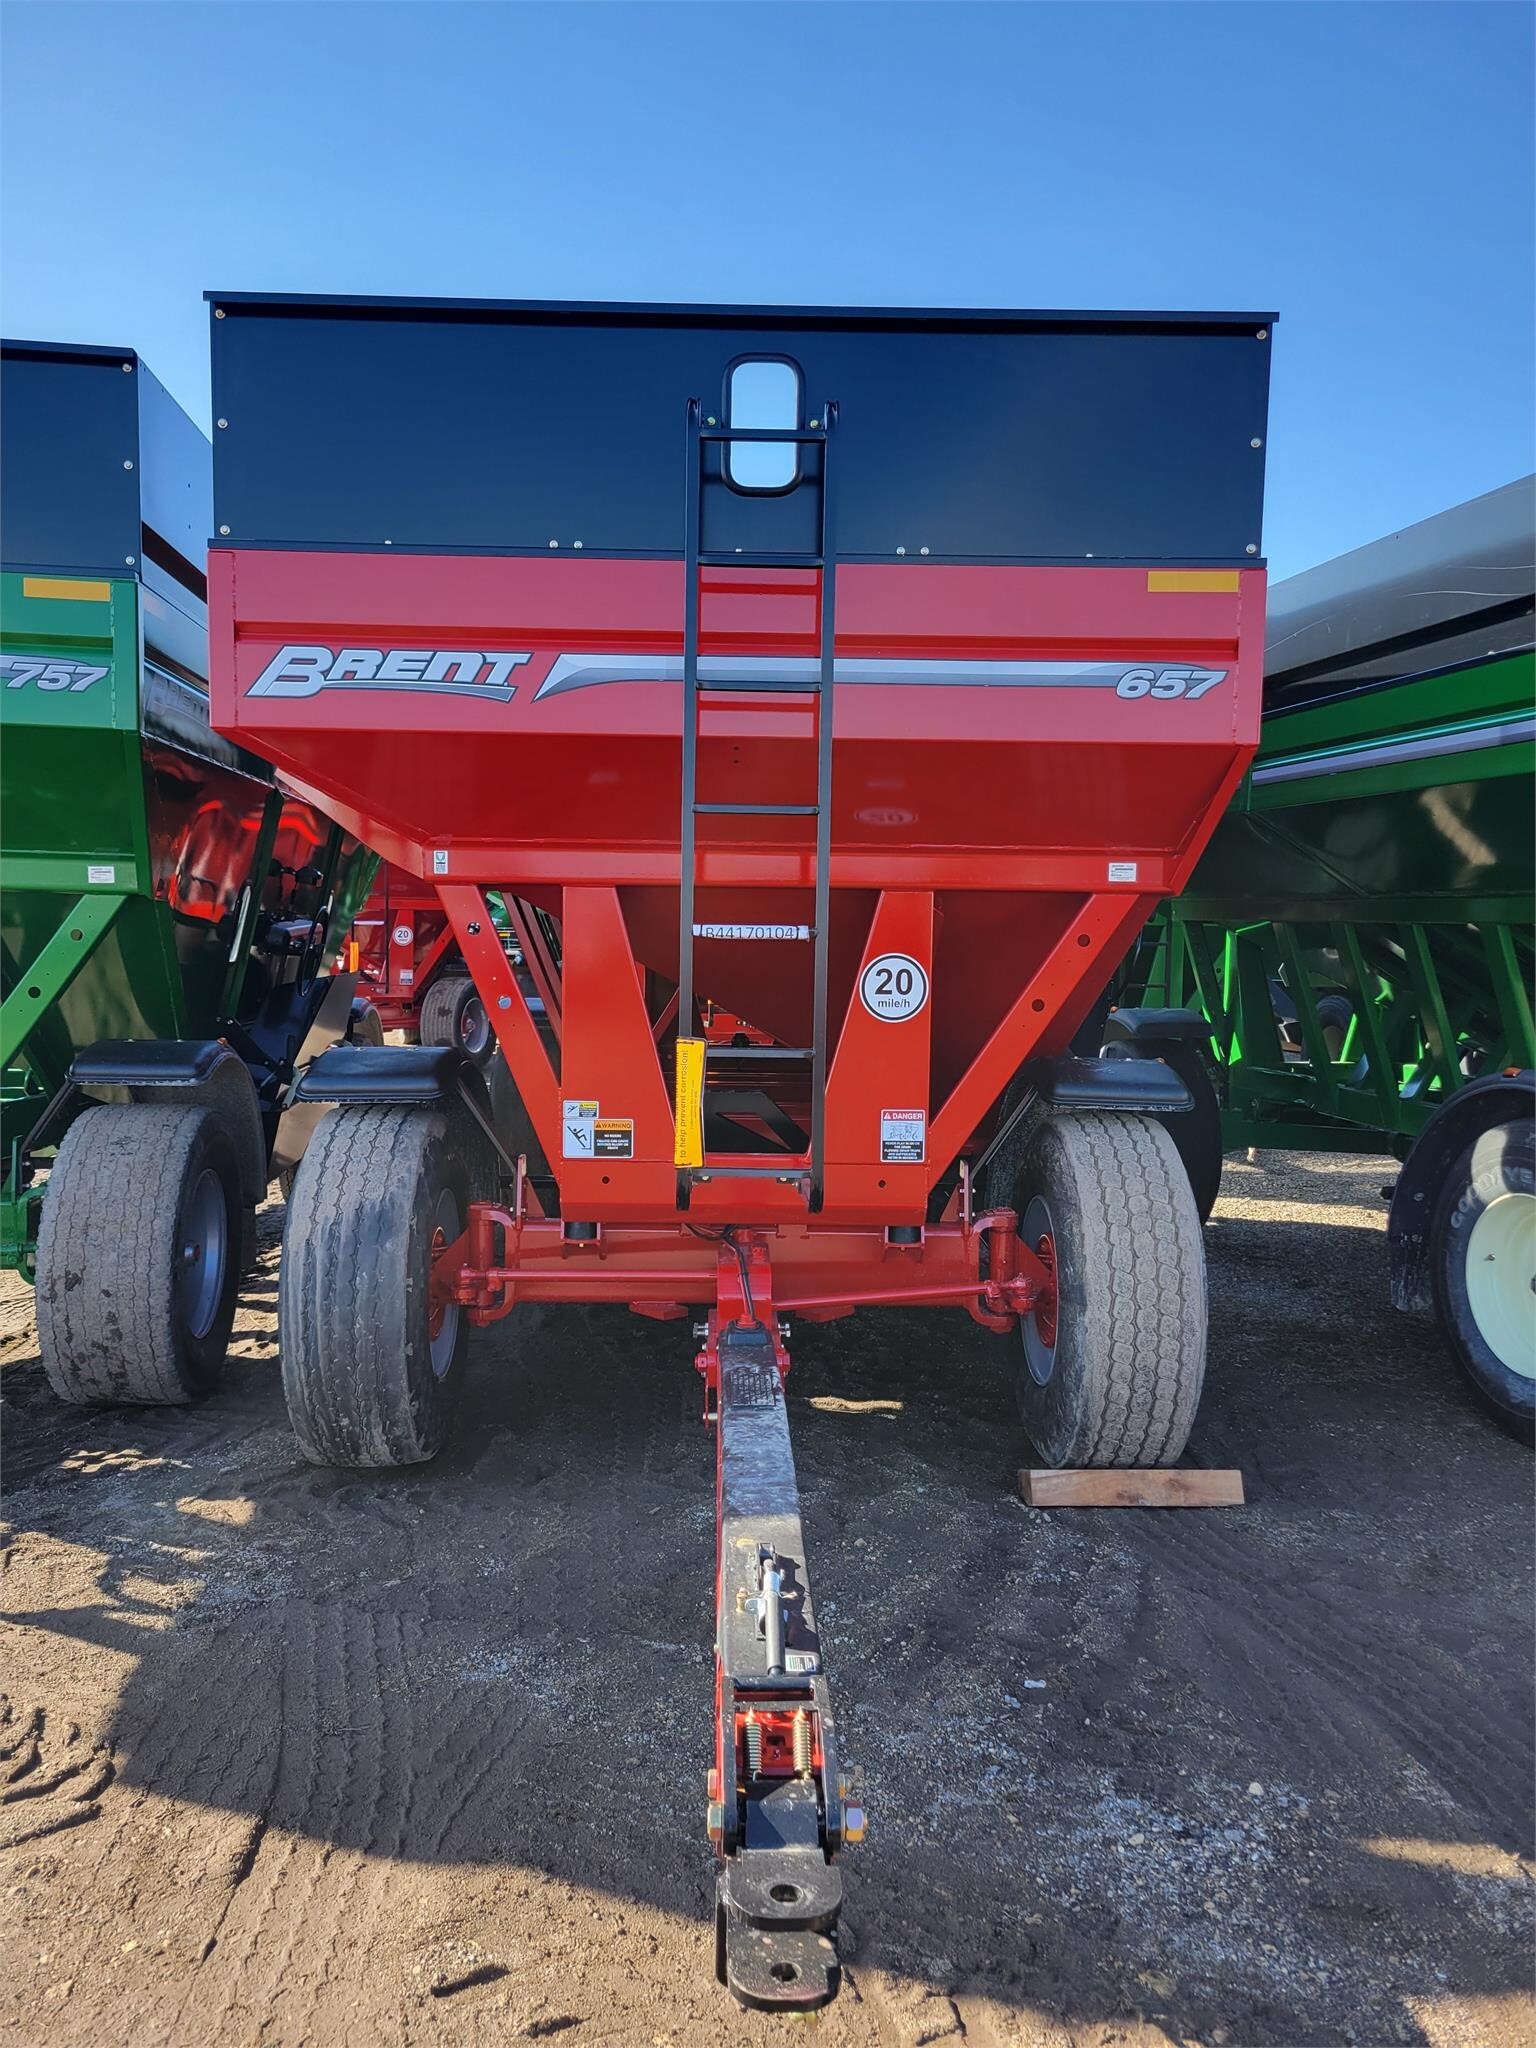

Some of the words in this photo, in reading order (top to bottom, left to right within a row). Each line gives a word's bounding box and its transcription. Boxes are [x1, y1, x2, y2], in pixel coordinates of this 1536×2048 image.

[6, 661, 111, 693] 757
[245, 645, 533, 699] BRENT
[1116, 668, 1229, 700] 657
[396, 930, 409, 938] 20
[875, 968, 913, 996] 20
[878, 998, 911, 1008] mile/h
[892, 1112, 923, 1120] DANGER
[679, 1129, 687, 1148] help
[680, 1149, 687, 1158] to
[1450, 1165, 1535, 1229] GOODYE
